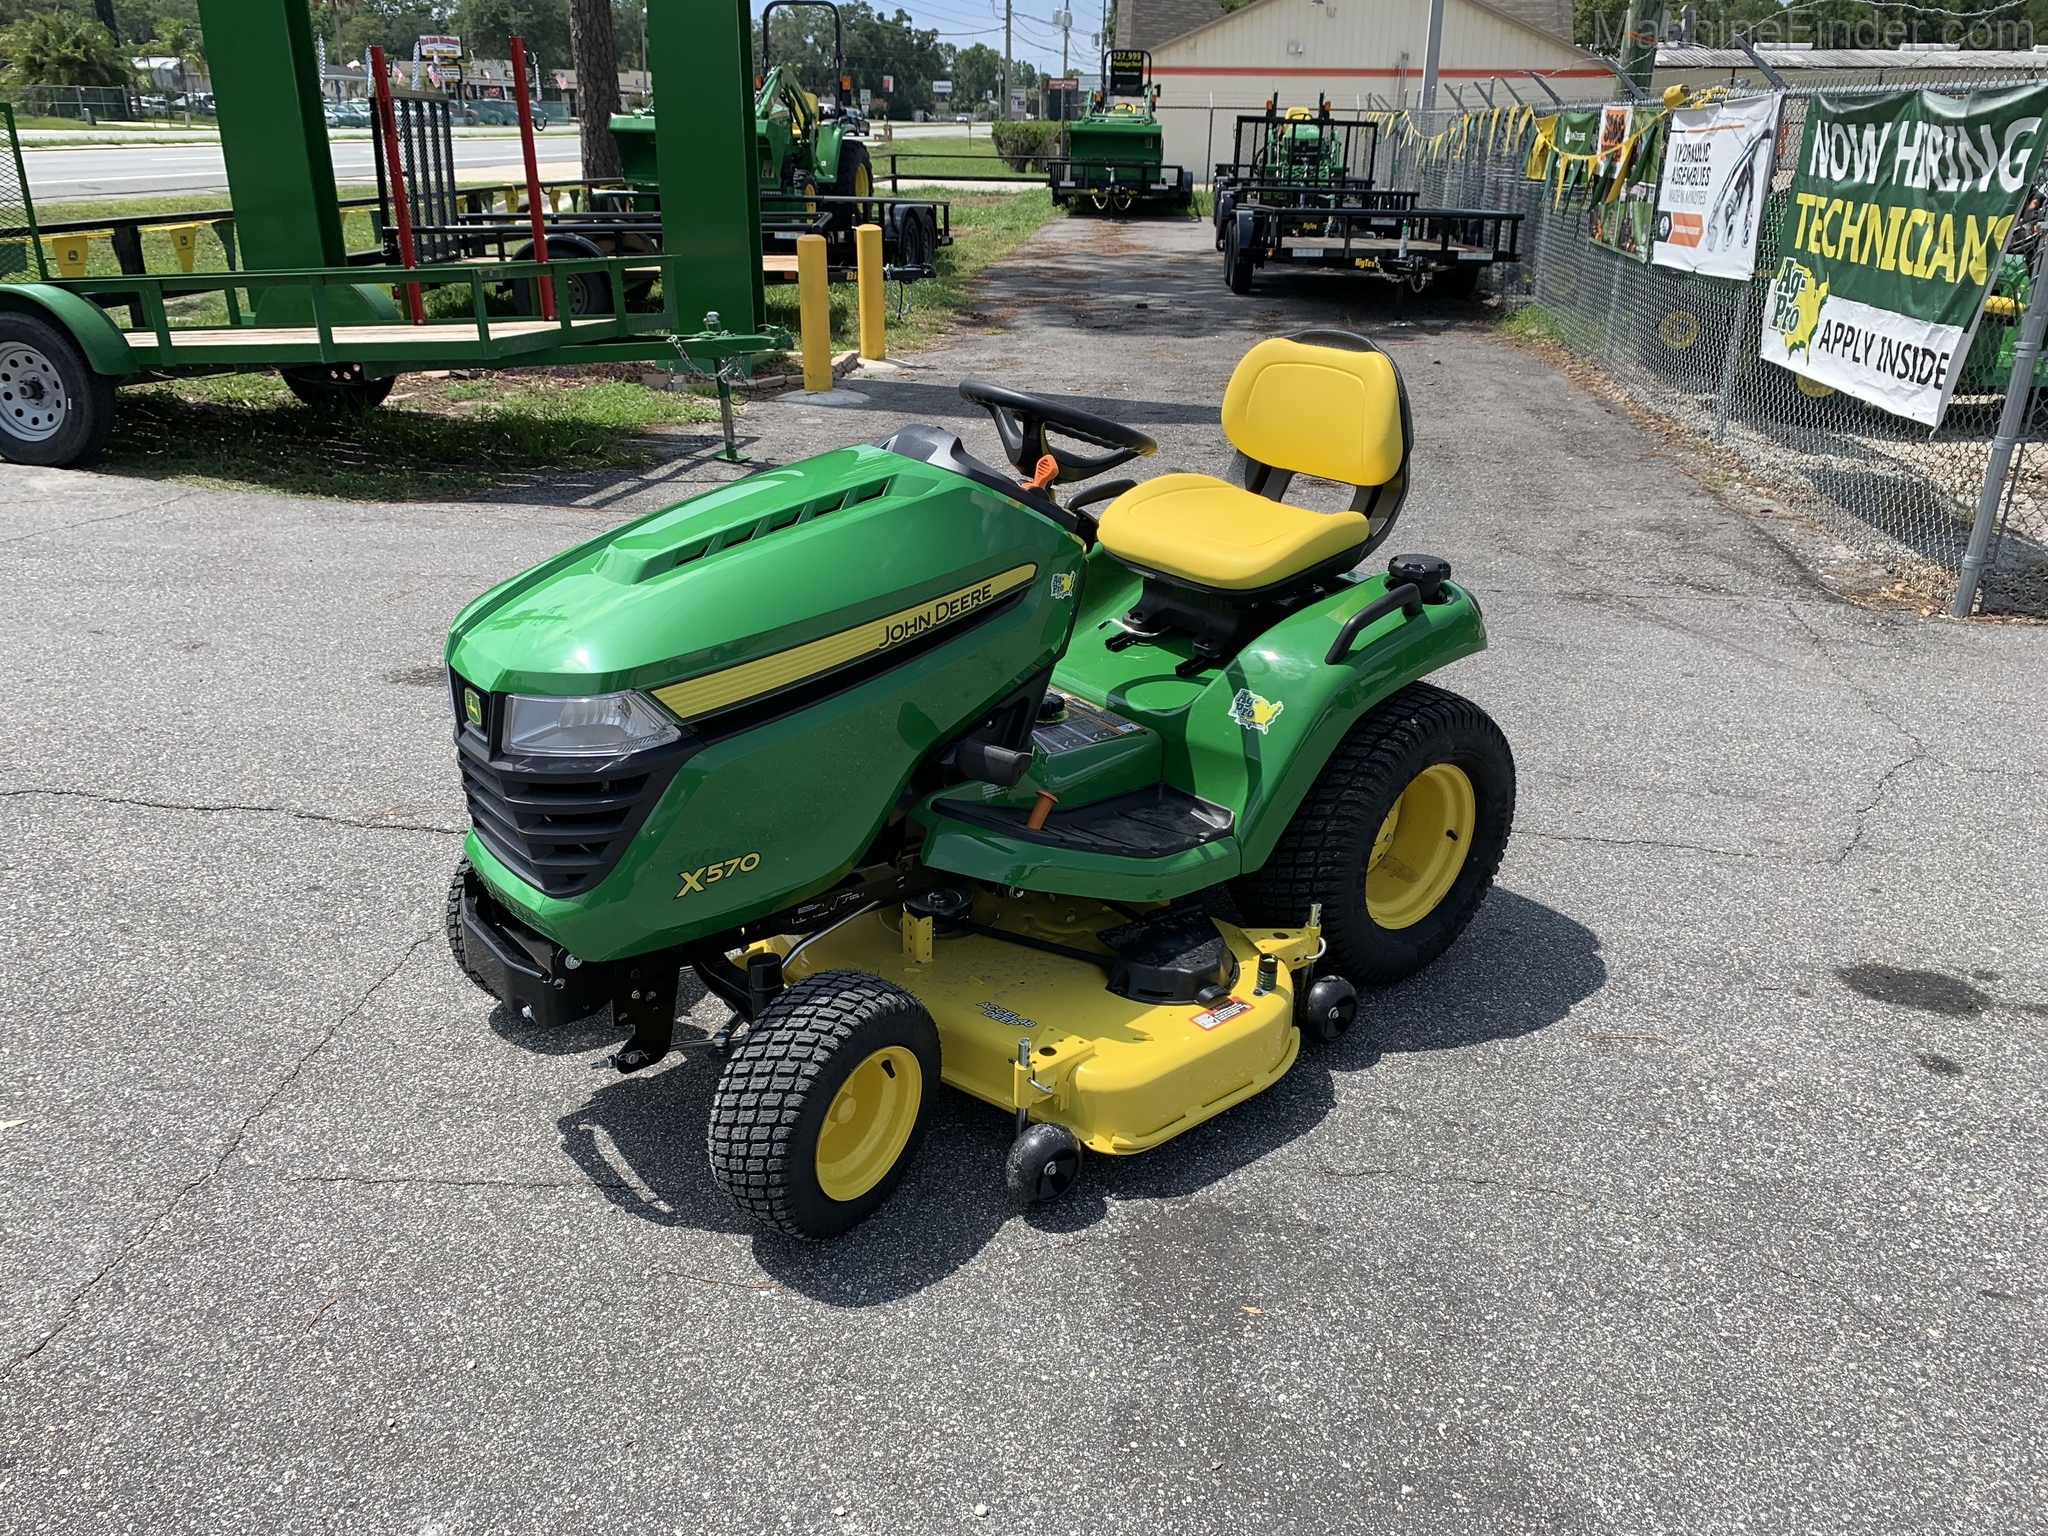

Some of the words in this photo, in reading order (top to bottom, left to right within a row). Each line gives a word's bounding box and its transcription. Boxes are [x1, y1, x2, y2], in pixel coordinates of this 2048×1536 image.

[1113, 52, 1142, 61] $27,999
[1809, 119, 1892, 184] NOW
[1892, 117, 2042, 193] HIRING
[1769, 293, 1800, 335] Pro
[1818, 319, 1876, 366] APPLY
[1876, 336, 1950, 390] INSIDE
[879, 611, 932, 648] JOHN
[935, 583, 994, 624] DEERE
[674, 852, 761, 900] X570
[975, 1001, 1020, 1020] ACCEL
[981, 1010, 1020, 1026] DEEP
